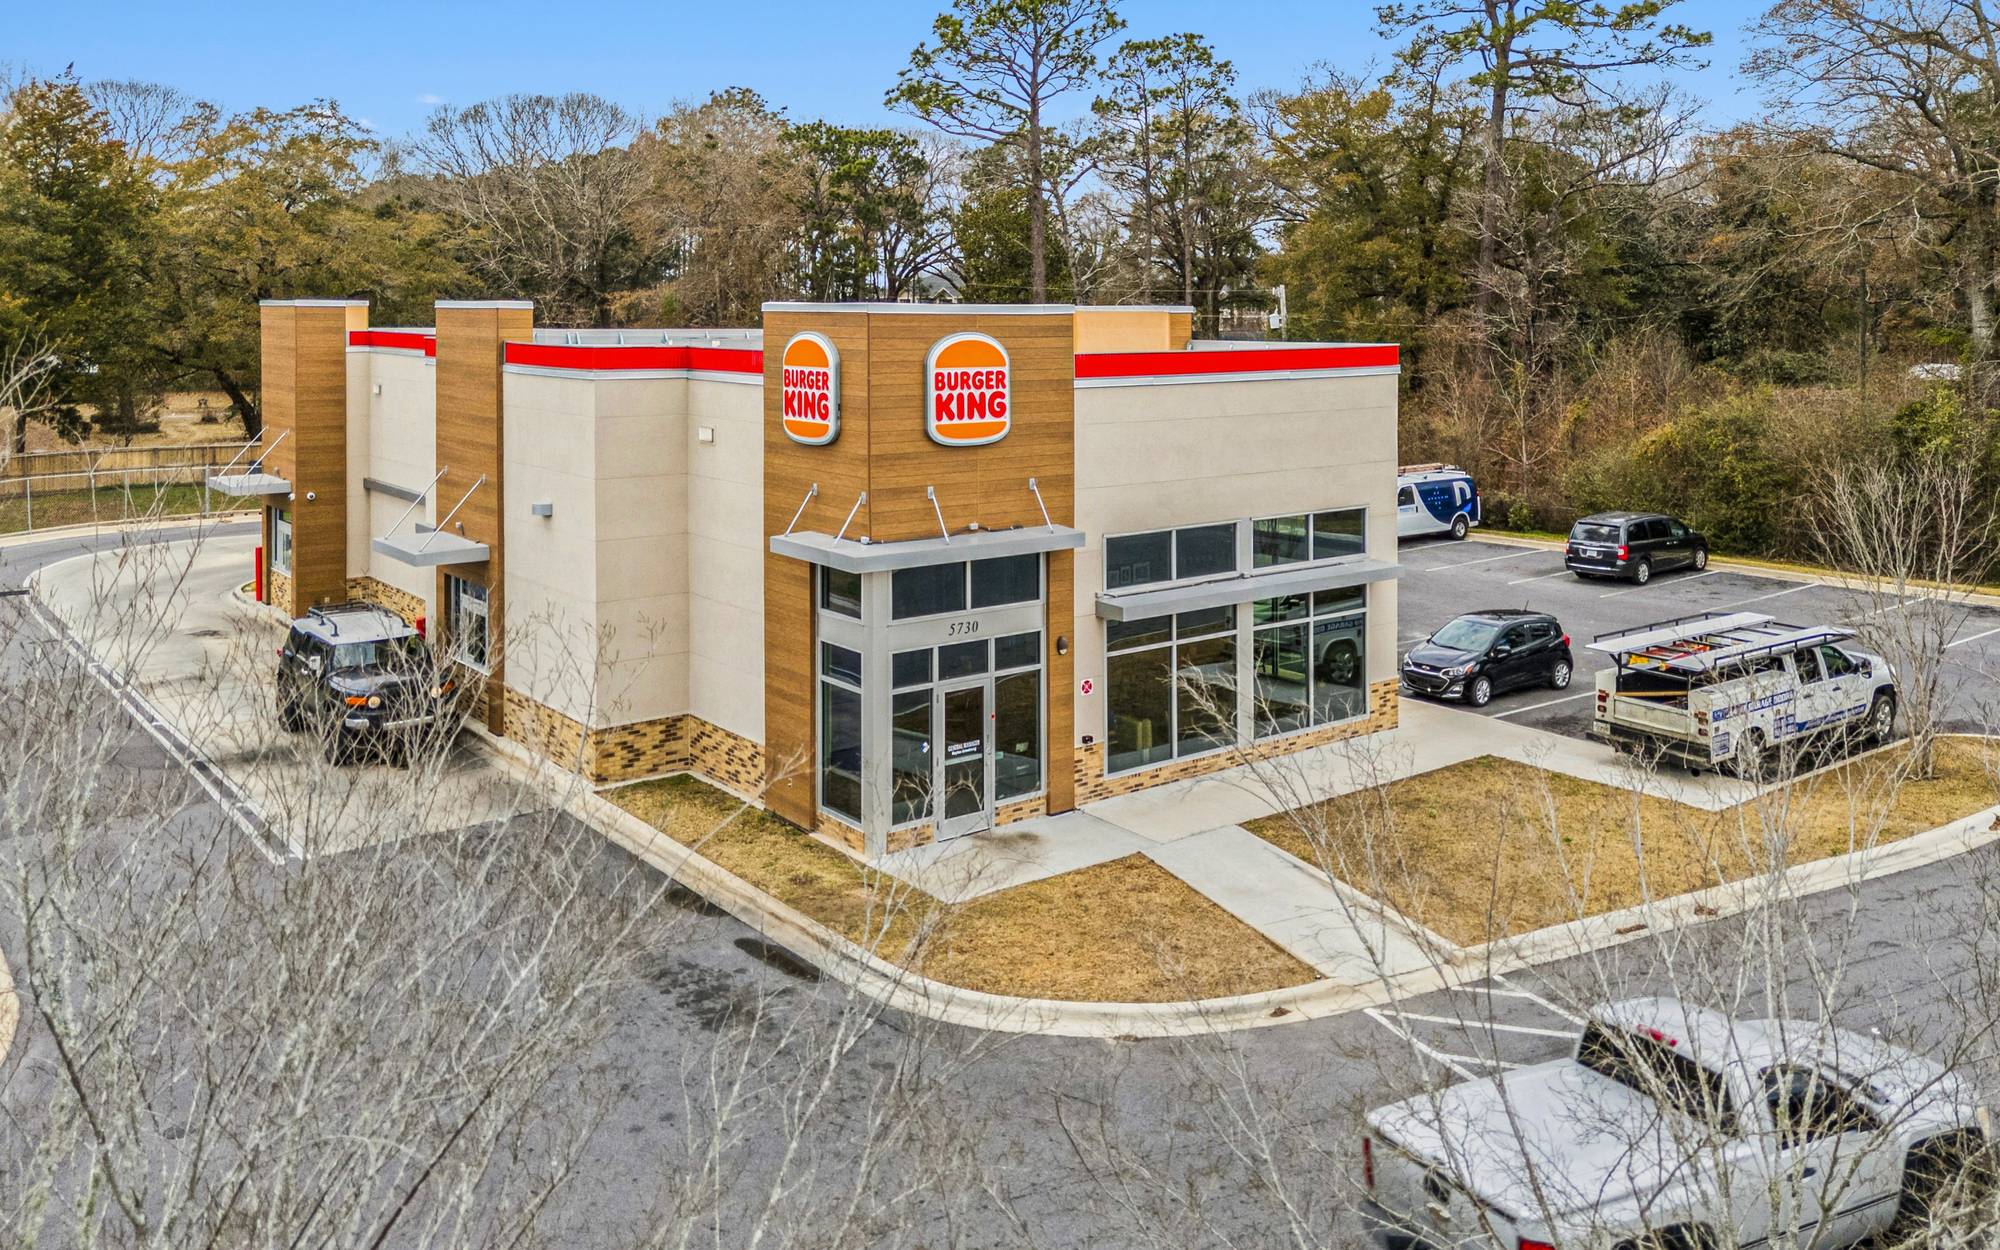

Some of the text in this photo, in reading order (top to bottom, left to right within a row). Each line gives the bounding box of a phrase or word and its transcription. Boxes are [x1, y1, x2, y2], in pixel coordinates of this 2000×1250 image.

[784, 369, 829, 391] BURGER
[935, 370, 1006, 391] BURGER
[784, 390, 829, 421] KING
[935, 391, 1007, 422] KING
[948, 621, 979, 636] 5730
